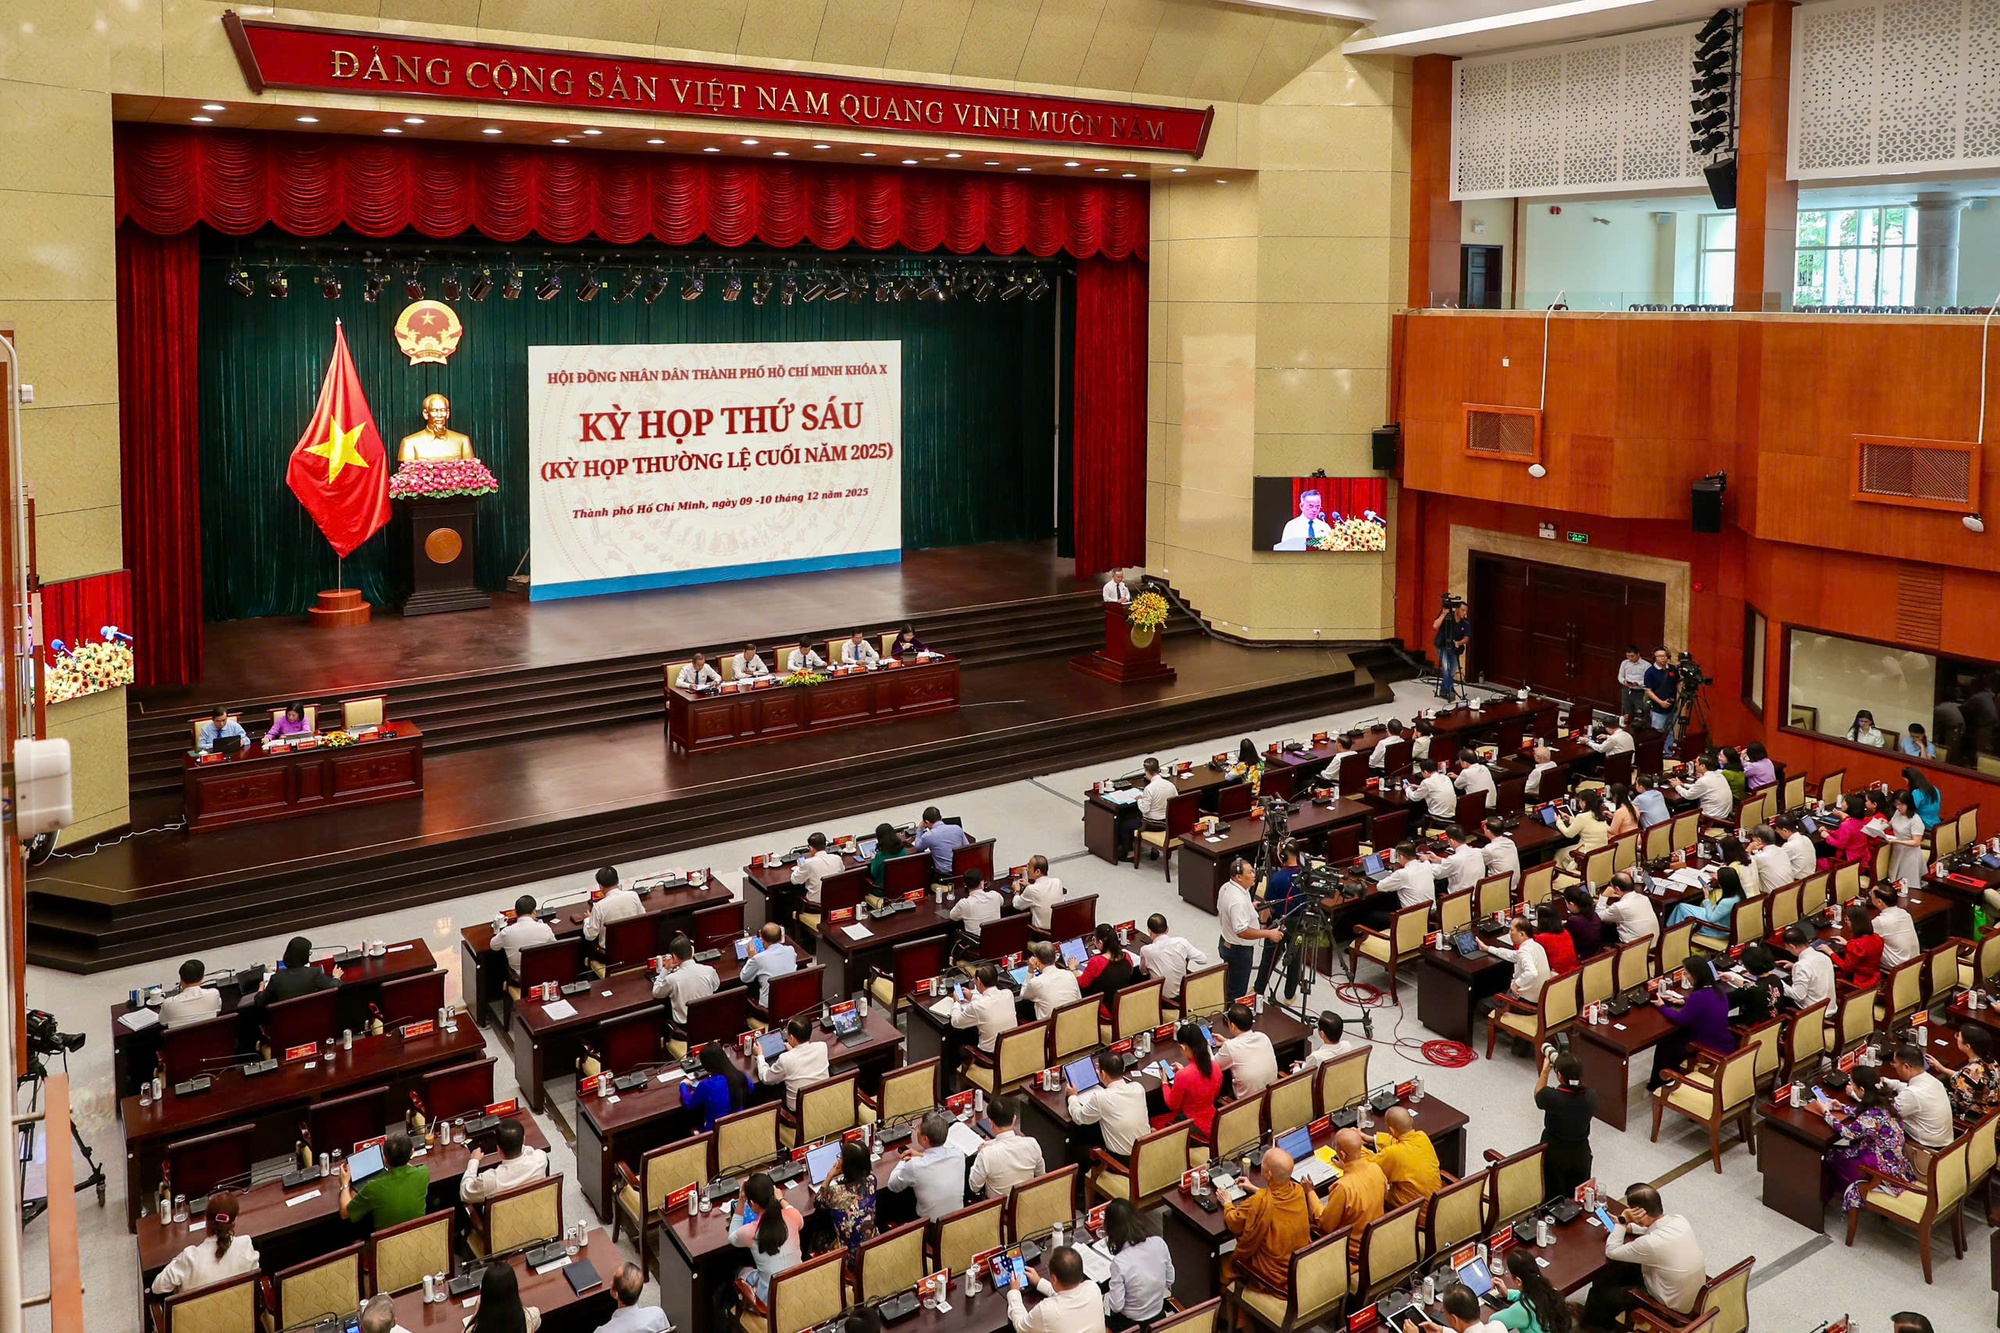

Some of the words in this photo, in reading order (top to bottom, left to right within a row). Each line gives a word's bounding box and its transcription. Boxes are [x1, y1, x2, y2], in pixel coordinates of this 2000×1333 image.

[331, 45, 452, 86] ĐẢNG
[466, 59, 574, 96] CỘNG
[588, 67, 658, 102] SẢN
[669, 78, 746, 112] VIỆT
[756, 86, 830, 116] NAM
[839, 93, 944, 124] QUANG
[953, 103, 1021, 131] VINH
[1028, 110, 1103, 136] MUÔN
[548, 369, 574, 386] HỘI
[577, 369, 617, 384] ĐỒNG
[620, 368, 659, 382] NHÂN
[661, 367, 690, 381] DÂN
[692, 367, 738, 381] THÀNH
[740, 366, 766, 379] PHỐ
[767, 364, 786, 378] HỒ
[788, 363, 809, 377] CHÍ
[811, 365, 843, 376] MINH
[846, 362, 878, 375] KHÓA
[879, 364, 888, 374] X
[579, 403, 632, 442] KỲ
[638, 409, 715, 445] HỌP
[720, 397, 796, 436] THỨ
[801, 395, 864, 432] SÁU
[540, 456, 580, 483] (KỲ
[583, 459, 630, 480] HỌP
[632, 450, 724, 475] THƯỜNG
[727, 446, 751, 472] LỆ
[755, 443, 801, 467] CUỐI
[804, 442, 848, 463] NĂM
[850, 442, 894, 461] 2025)
[572, 507, 608, 519] Thành
[612, 503, 635, 518] phố
[656, 501, 676, 513] Chí
[677, 499, 710, 512] Minh,
[711, 497, 738, 510] ngày
[740, 497, 753, 506] 09
[774, 493, 804, 504] tháng
[807, 491, 819, 501] 12
[821, 490, 843, 500] năm
[845, 488, 869, 498] 2025
